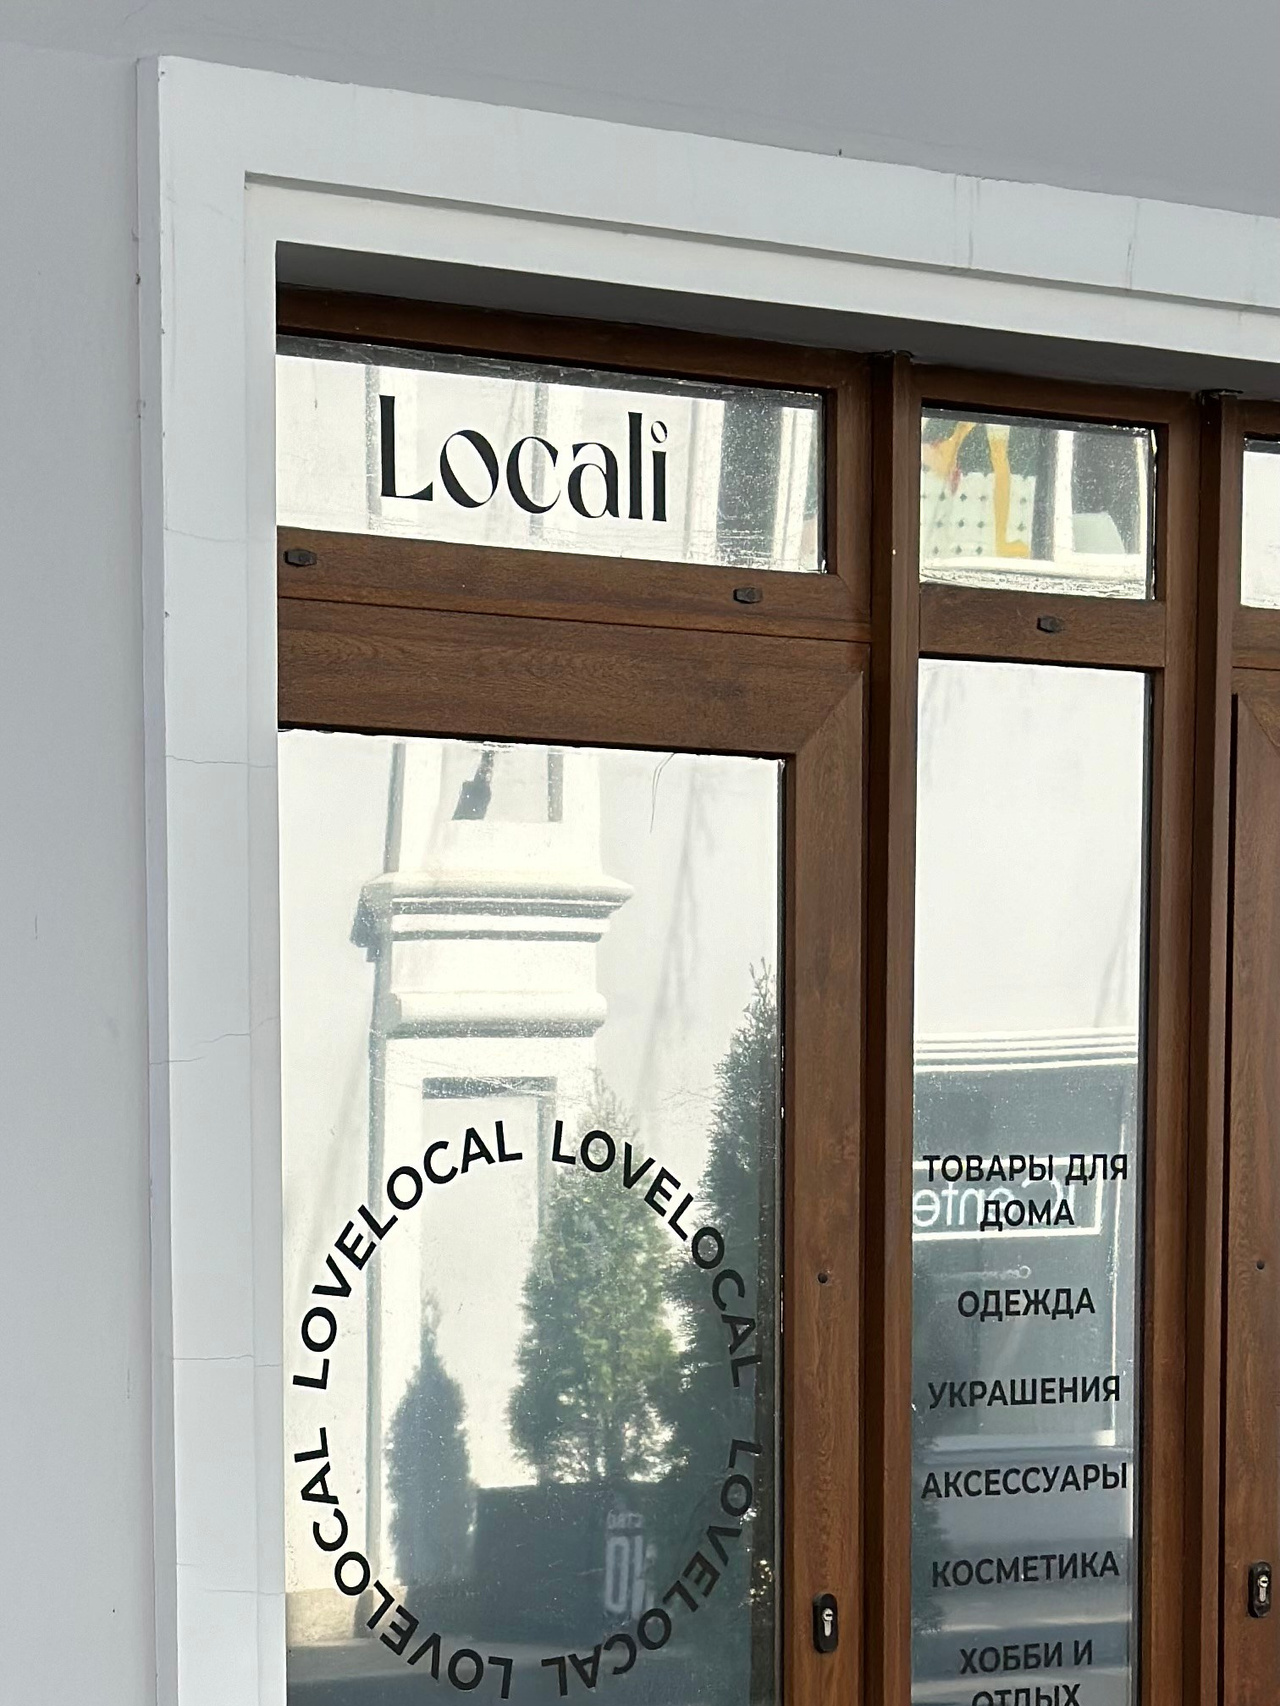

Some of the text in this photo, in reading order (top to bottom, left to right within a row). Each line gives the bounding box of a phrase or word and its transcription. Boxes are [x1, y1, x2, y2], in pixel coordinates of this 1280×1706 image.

[379, 395, 668, 522] Locali
[923, 1154, 1128, 1185] ТОВАРЫ ДЛЯ
[980, 1199, 1075, 1231] ДОМА
[958, 1288, 1095, 1322] ОДЕЖДА
[293, 1120, 762, 1699] LOVELOCAL LOVELOCAL LOVELOCAL LOVELOCAL
[928, 1375, 1120, 1409] УКРАШЕНИЯ
[921, 1462, 1127, 1499] АКСЕССУАРЫ
[932, 1550, 1120, 1588] КОСМЕТИКА
[959, 1639, 1093, 1675] ХОББИ И
